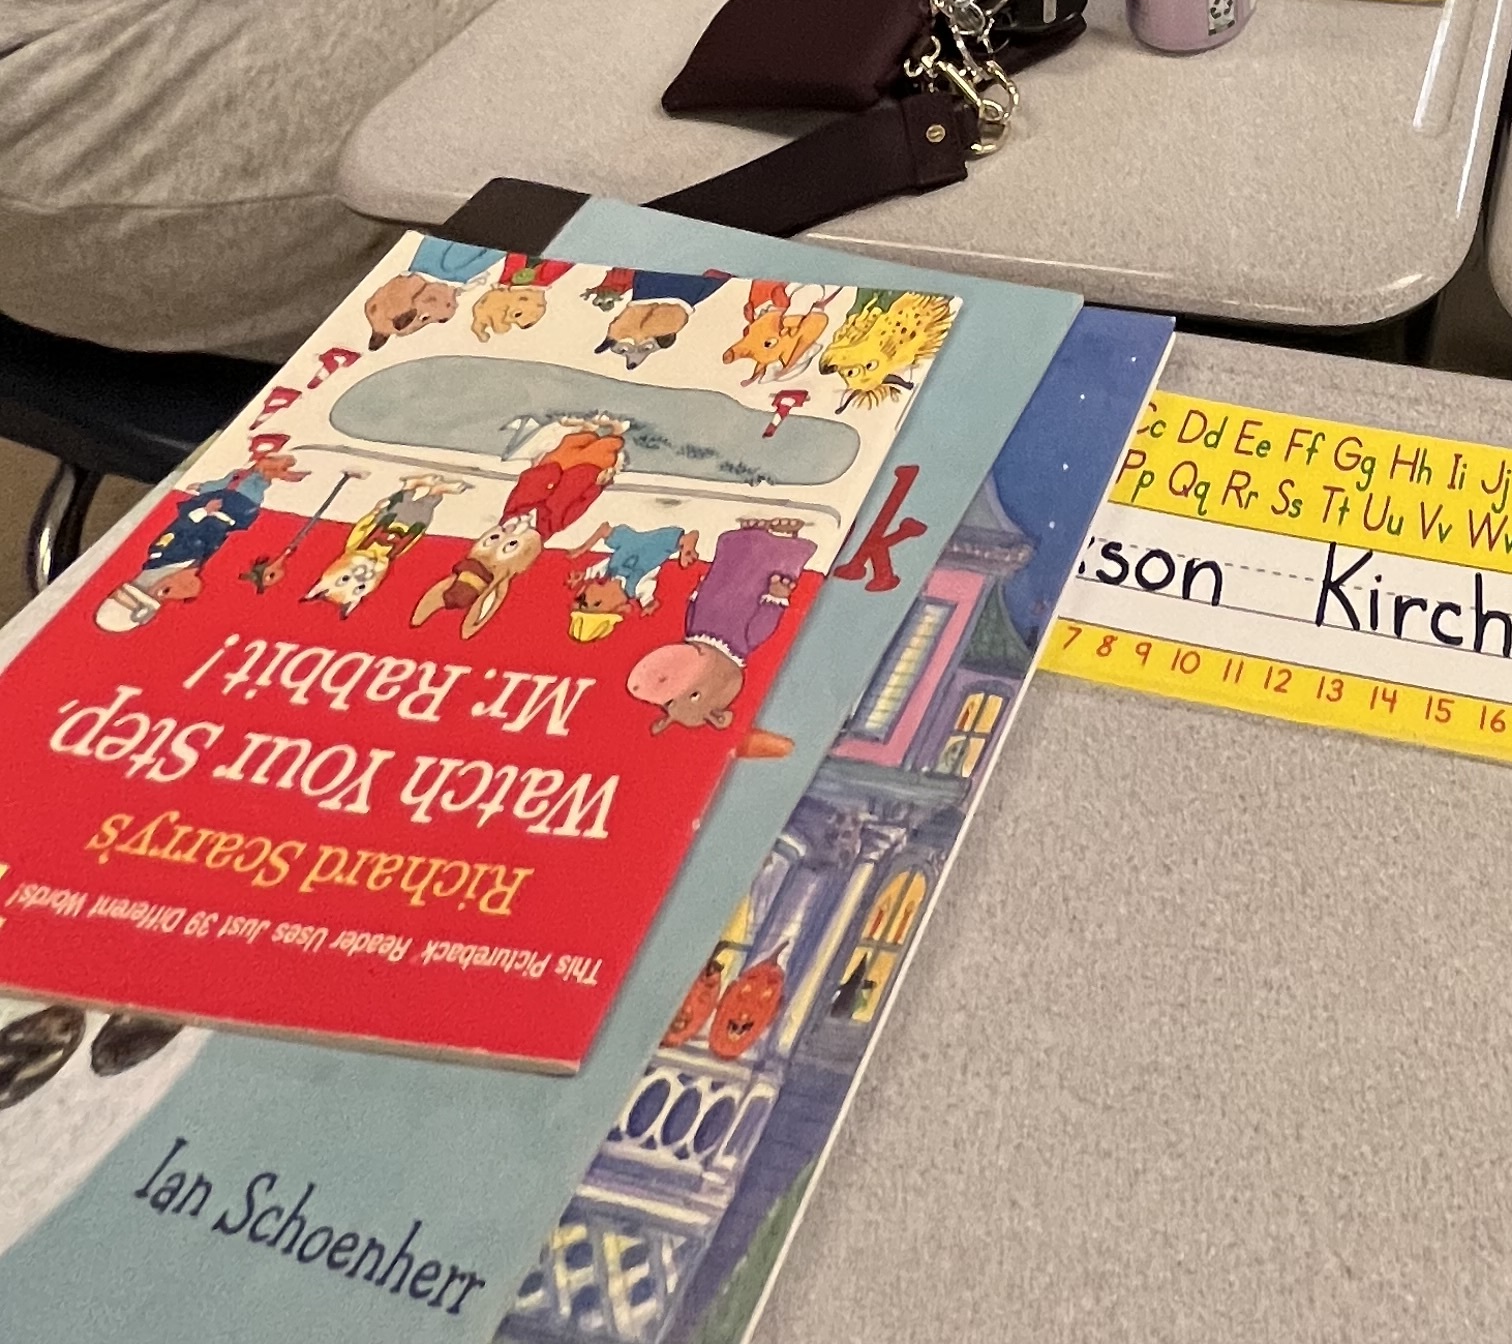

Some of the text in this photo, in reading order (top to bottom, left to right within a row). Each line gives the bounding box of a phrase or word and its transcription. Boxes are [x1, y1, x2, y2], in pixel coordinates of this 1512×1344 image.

[1116, 449, 1154, 496] Pp
[1168, 460, 1208, 516] Qq
[1223, 470, 1258, 508] Rr
[1272, 479, 1302, 518] Ss
[1322, 485, 1348, 525] Tt
[1363, 492, 1402, 536] Uu
[1420, 502, 1451, 543] Vv
[1178, 410, 1226, 449] Dd
[1234, 419, 1271, 458] Ee
[1285, 428, 1324, 467] Ff
[1334, 437, 1376, 490] Gg
[1389, 445, 1432, 487] Hh
[1447, 454, 1464, 490] Ii
[1481, 458, 1511, 513] Jj
[1079, 536, 1223, 607] son
[183, 633, 596, 737] Mr. Rabbit!
[1062, 627, 1077, 649] 7
[1098, 635, 1115, 657] 8
[1136, 642, 1151, 665] 9
[1171, 648, 1200, 674] 10
[1224, 658, 1242, 682] 11
[1264, 667, 1292, 693] 12
[1318, 677, 1343, 702] 13
[1370, 686, 1397, 713] 14
[1425, 697, 1452, 723] 15
[1480, 707, 1506, 733] 16
[49, 686, 620, 839] Watch Your Step,
[88, 810, 535, 916] Richard Scarry's
[5, 882, 602, 986] This Pictureback Reader Uses Just 39 Different Words!
[135, 1139, 486, 1316] Ian Schoenherr
